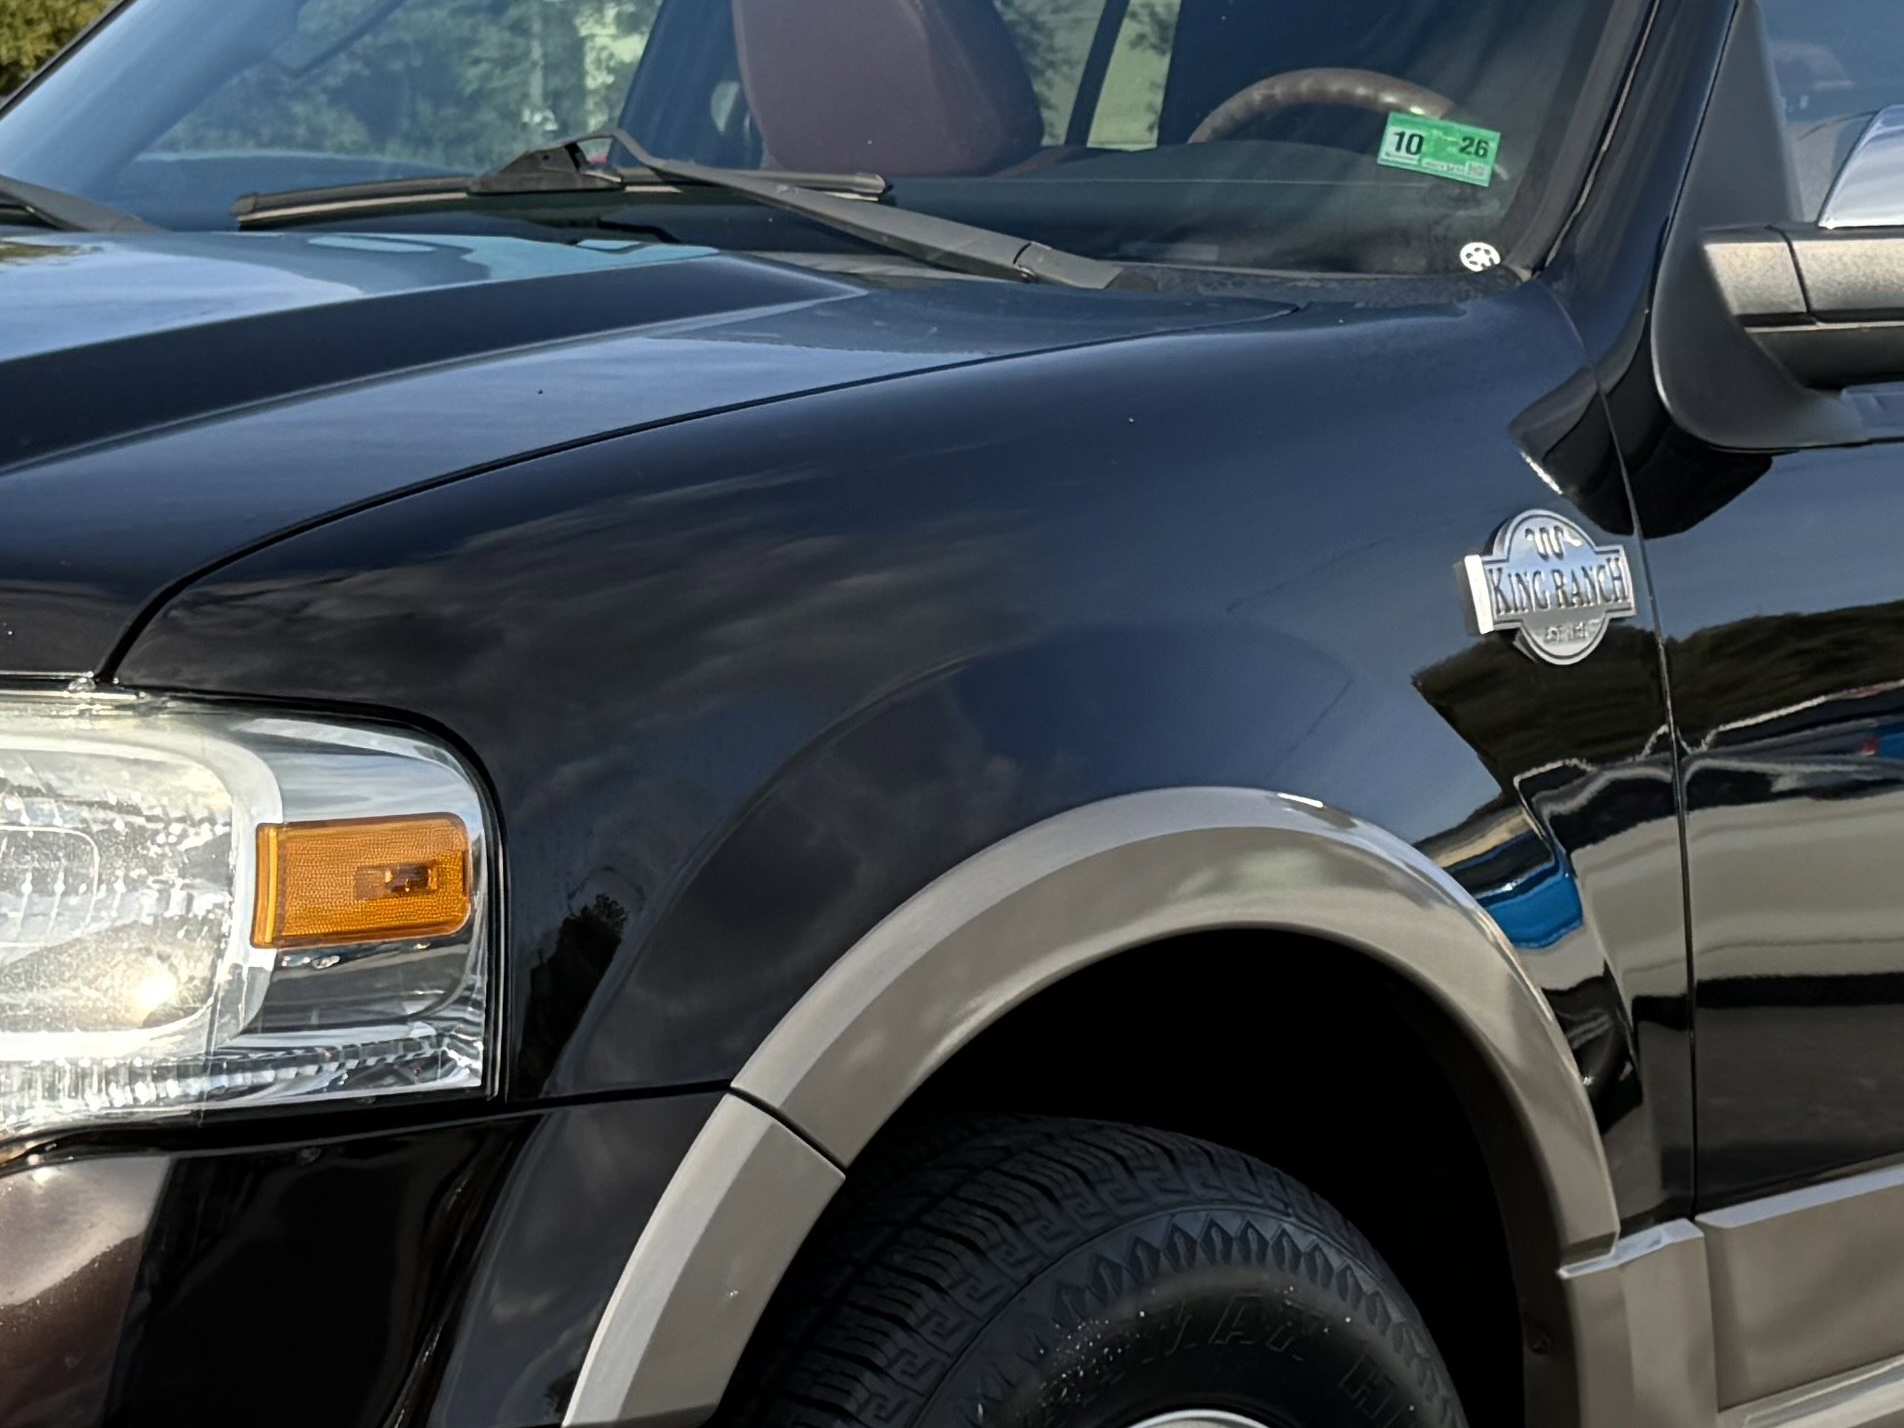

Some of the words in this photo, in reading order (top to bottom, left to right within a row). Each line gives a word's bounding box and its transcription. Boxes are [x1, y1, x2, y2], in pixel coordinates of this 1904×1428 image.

[1394, 131, 1424, 155] 10
[1459, 136, 1489, 158] 26
[1489, 567, 1550, 615] KING
[1552, 556, 1630, 609] RANCH
